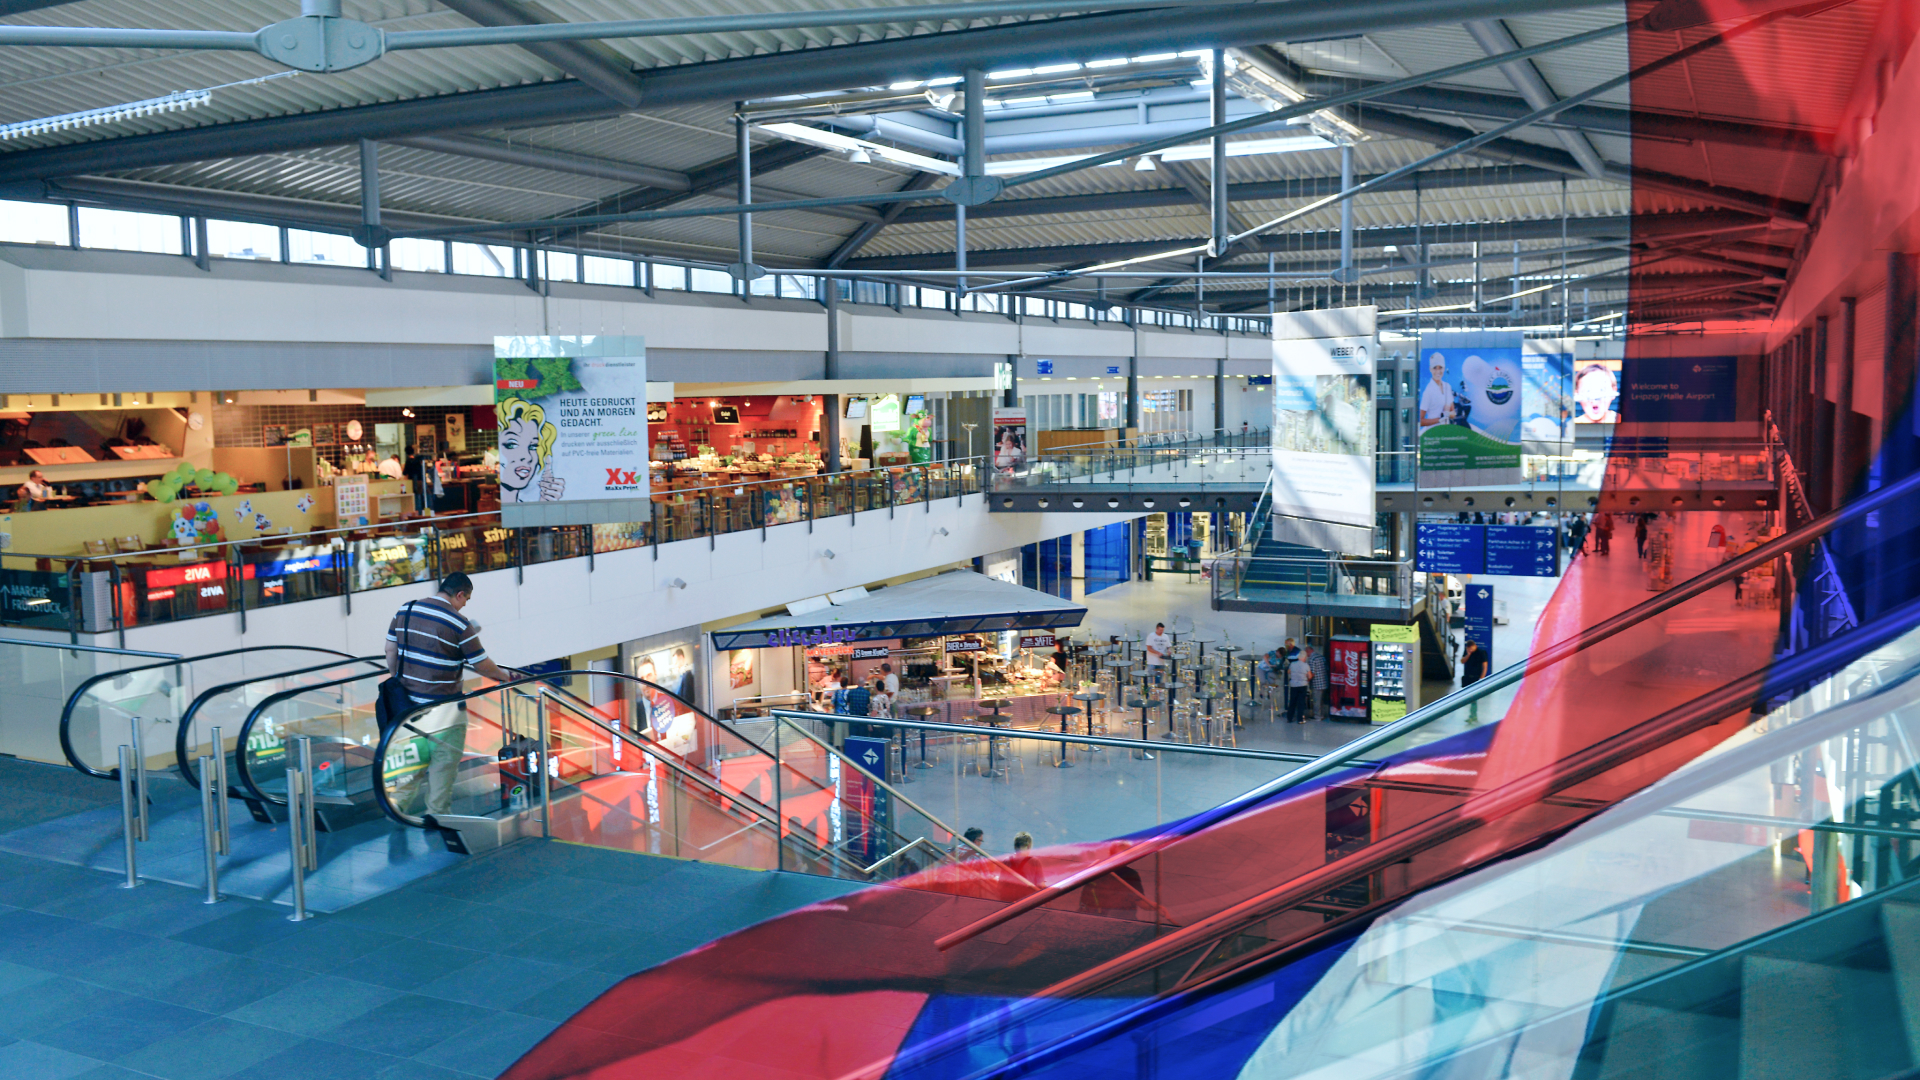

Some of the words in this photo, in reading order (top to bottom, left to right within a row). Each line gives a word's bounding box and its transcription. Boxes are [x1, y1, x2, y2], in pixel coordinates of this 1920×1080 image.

[1330, 347, 1354, 356] WEBER
[560, 398, 588, 407] HEUTE
[590, 398, 636, 406] GEDRUCKT
[597, 408, 636, 416] MORGEN
[561, 419, 603, 427] GEDACHT.
[593, 431, 616, 441] green
[768, 625, 856, 648] cliccadou
[1034, 636, 1054, 646] SÄFTE
[946, 642, 960, 651] BIER
